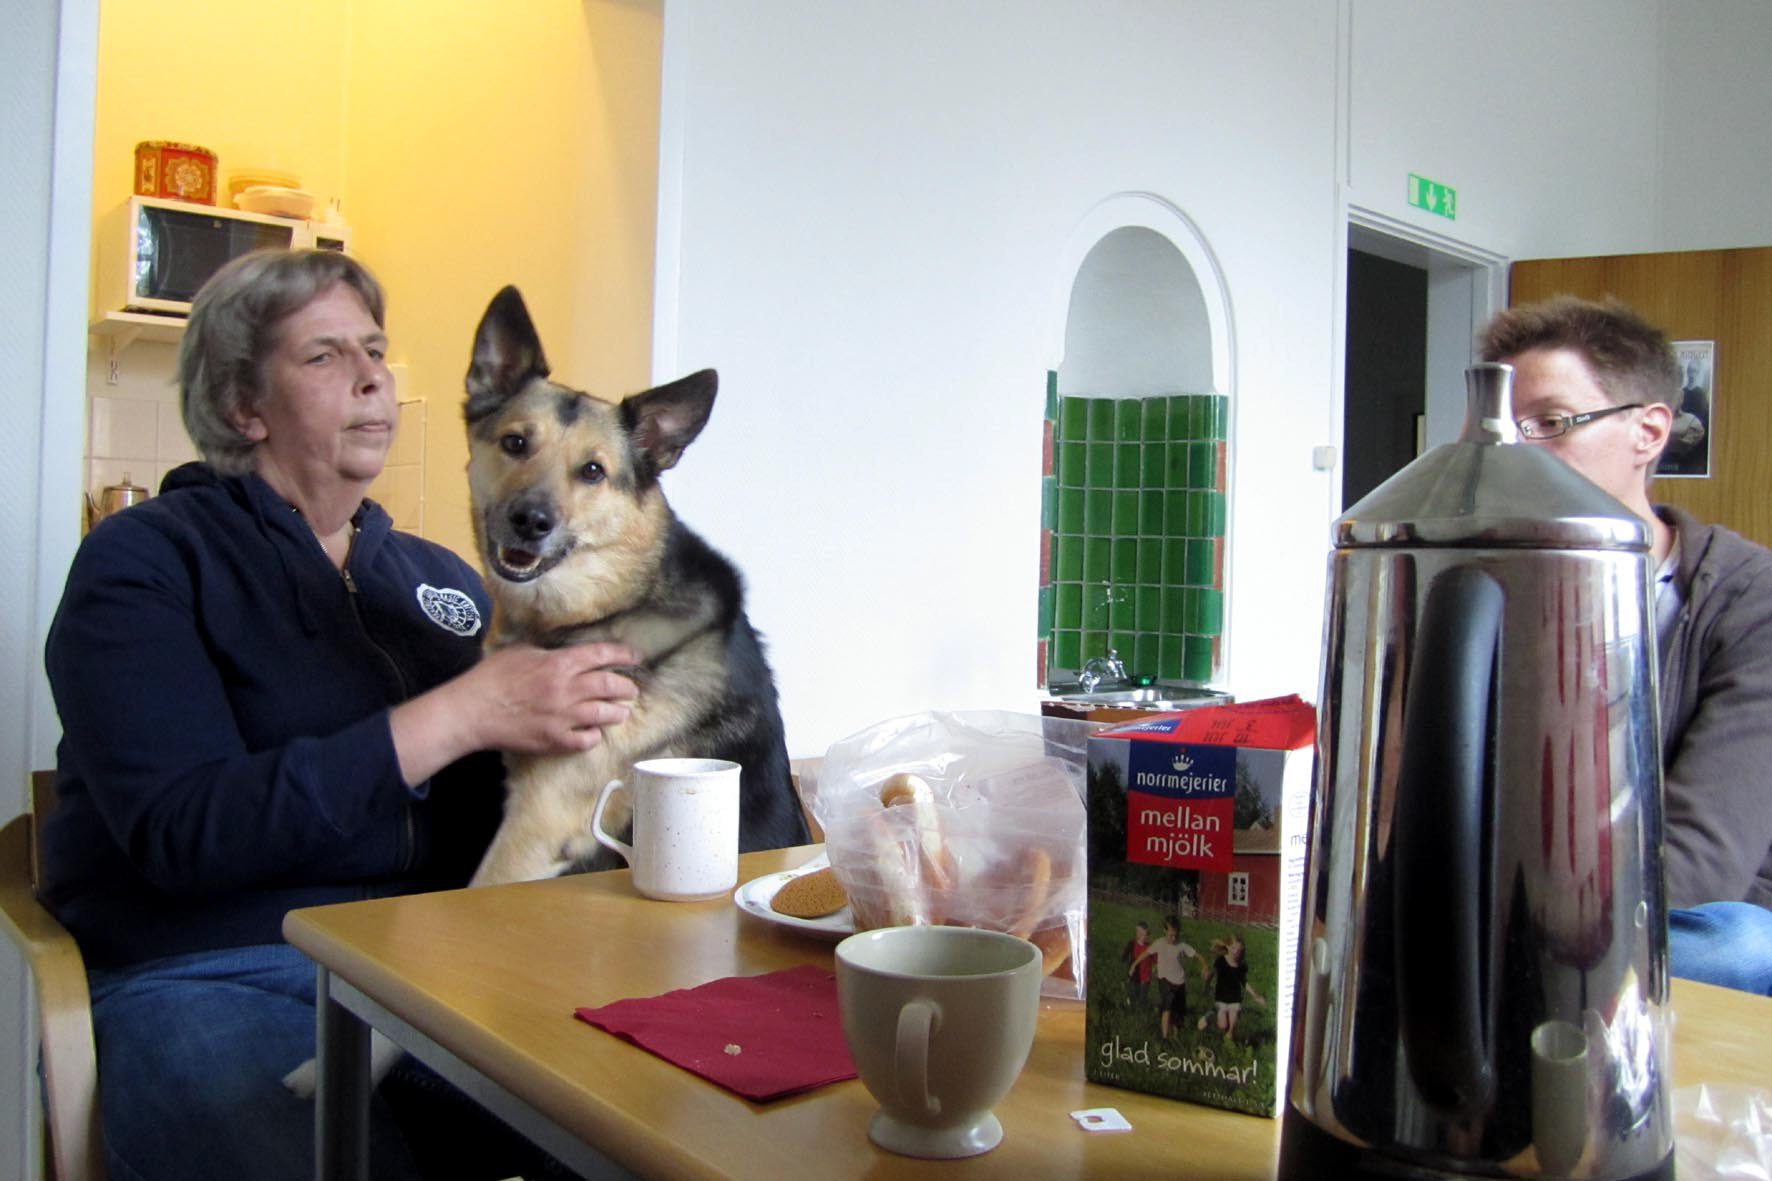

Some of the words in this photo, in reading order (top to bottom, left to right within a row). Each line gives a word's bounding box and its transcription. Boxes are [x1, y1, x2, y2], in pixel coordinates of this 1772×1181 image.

[1136, 771, 1227, 794] norrmejerier
[1140, 806, 1220, 832] mellan
[1146, 833, 1214, 861] mjölk
[1101, 1035, 1150, 1068] glad
[1157, 1050, 1257, 1085] sommar!
